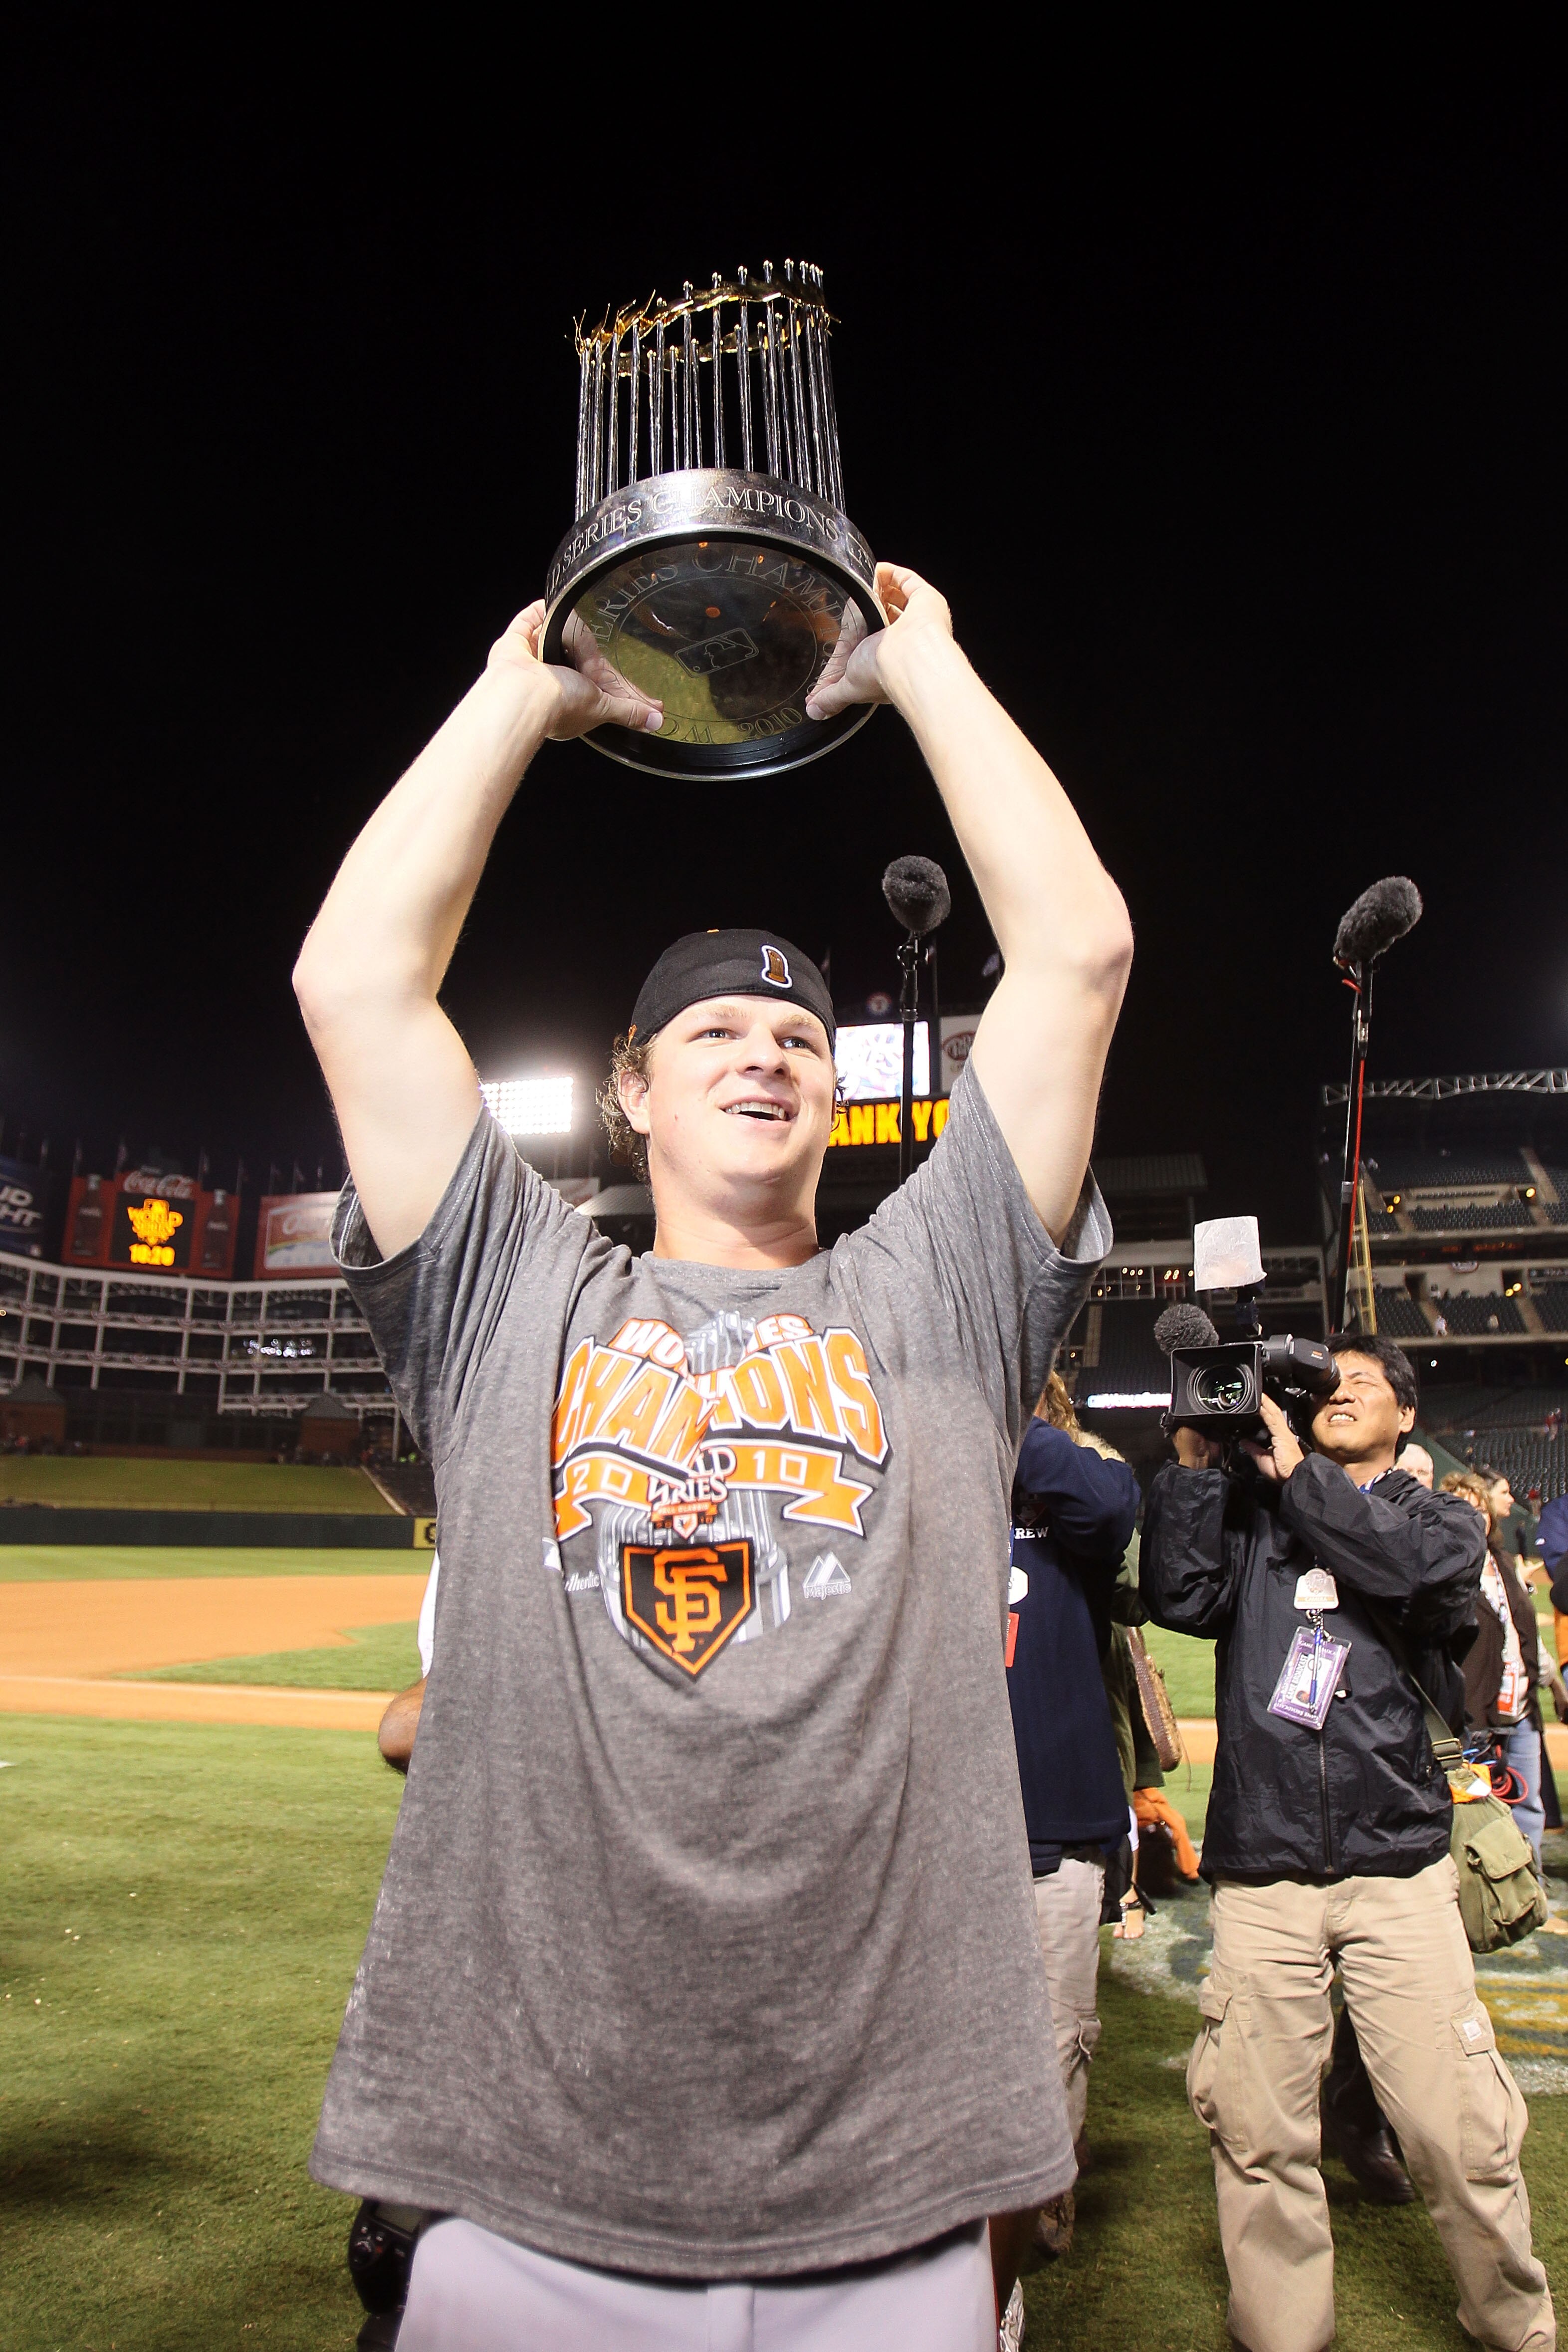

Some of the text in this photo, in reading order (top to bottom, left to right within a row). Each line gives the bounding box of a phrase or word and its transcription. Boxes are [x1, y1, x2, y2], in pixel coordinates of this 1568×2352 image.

[562, 486, 840, 564] SERIES CHAMPIONS
[737, 707, 803, 742] 2010
[829, 1099, 950, 1147] ANK YO
[1014, 1526, 1049, 1539] REW
